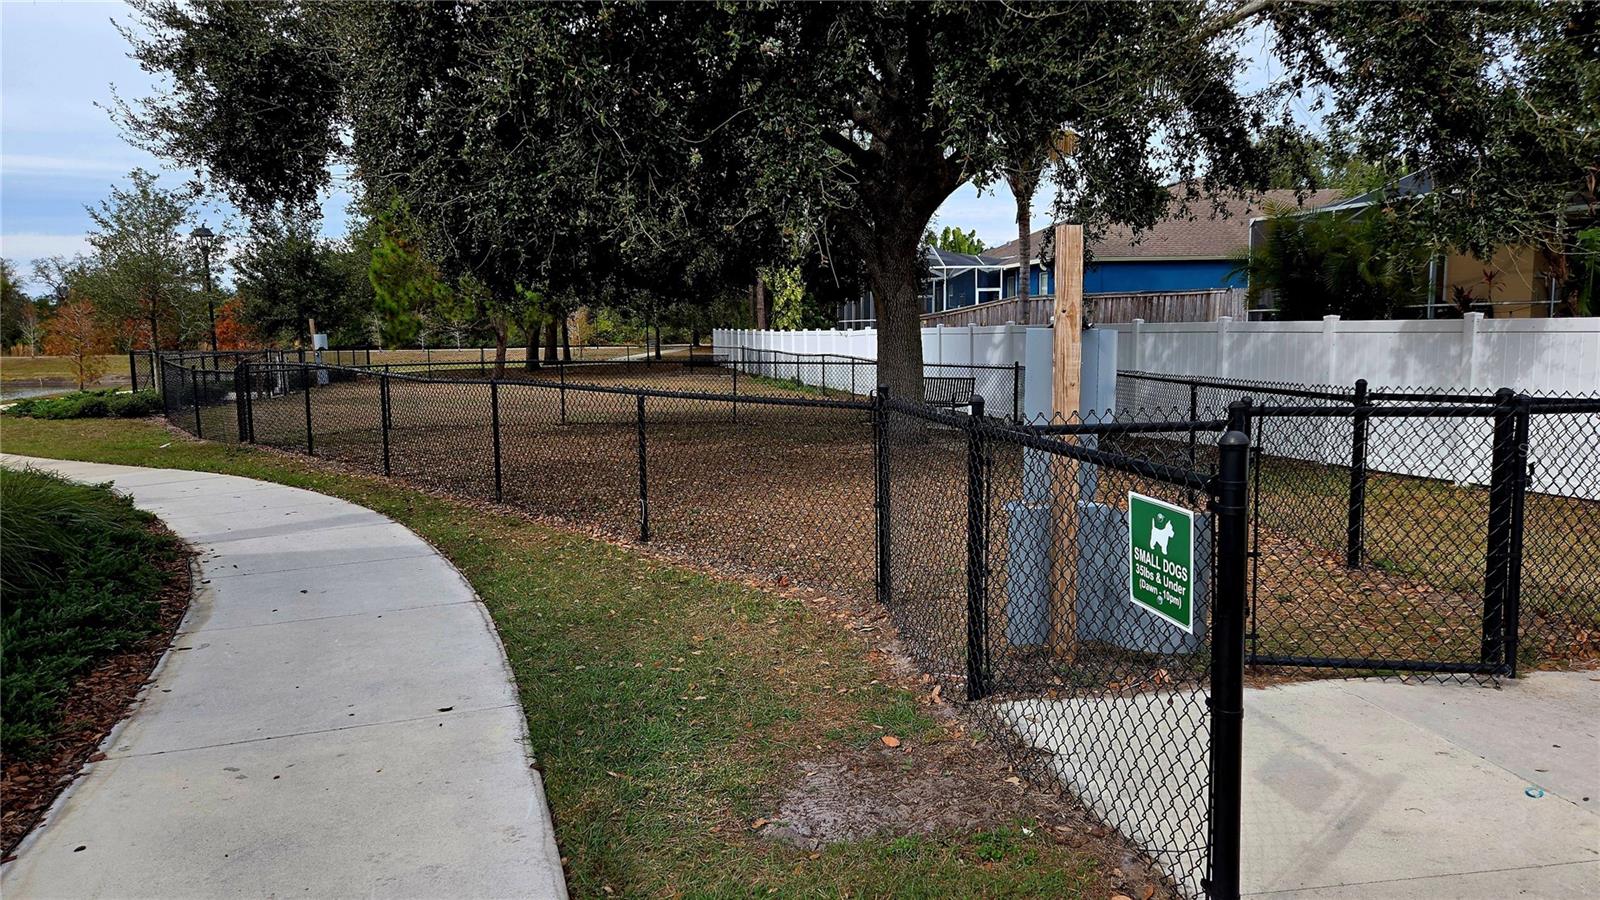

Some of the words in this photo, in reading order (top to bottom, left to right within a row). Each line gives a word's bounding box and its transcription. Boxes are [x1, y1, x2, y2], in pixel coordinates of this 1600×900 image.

[1134, 547, 1161, 570] SMALL
[1163, 559, 1188, 582] DOGS
[1135, 563, 1154, 581] 35lbs
[1155, 572, 1162, 584] &
[1163, 576, 1186, 595] Under
[1139, 578, 1158, 595] (Dawn
[1163, 590, 1182, 609] 10pm)
